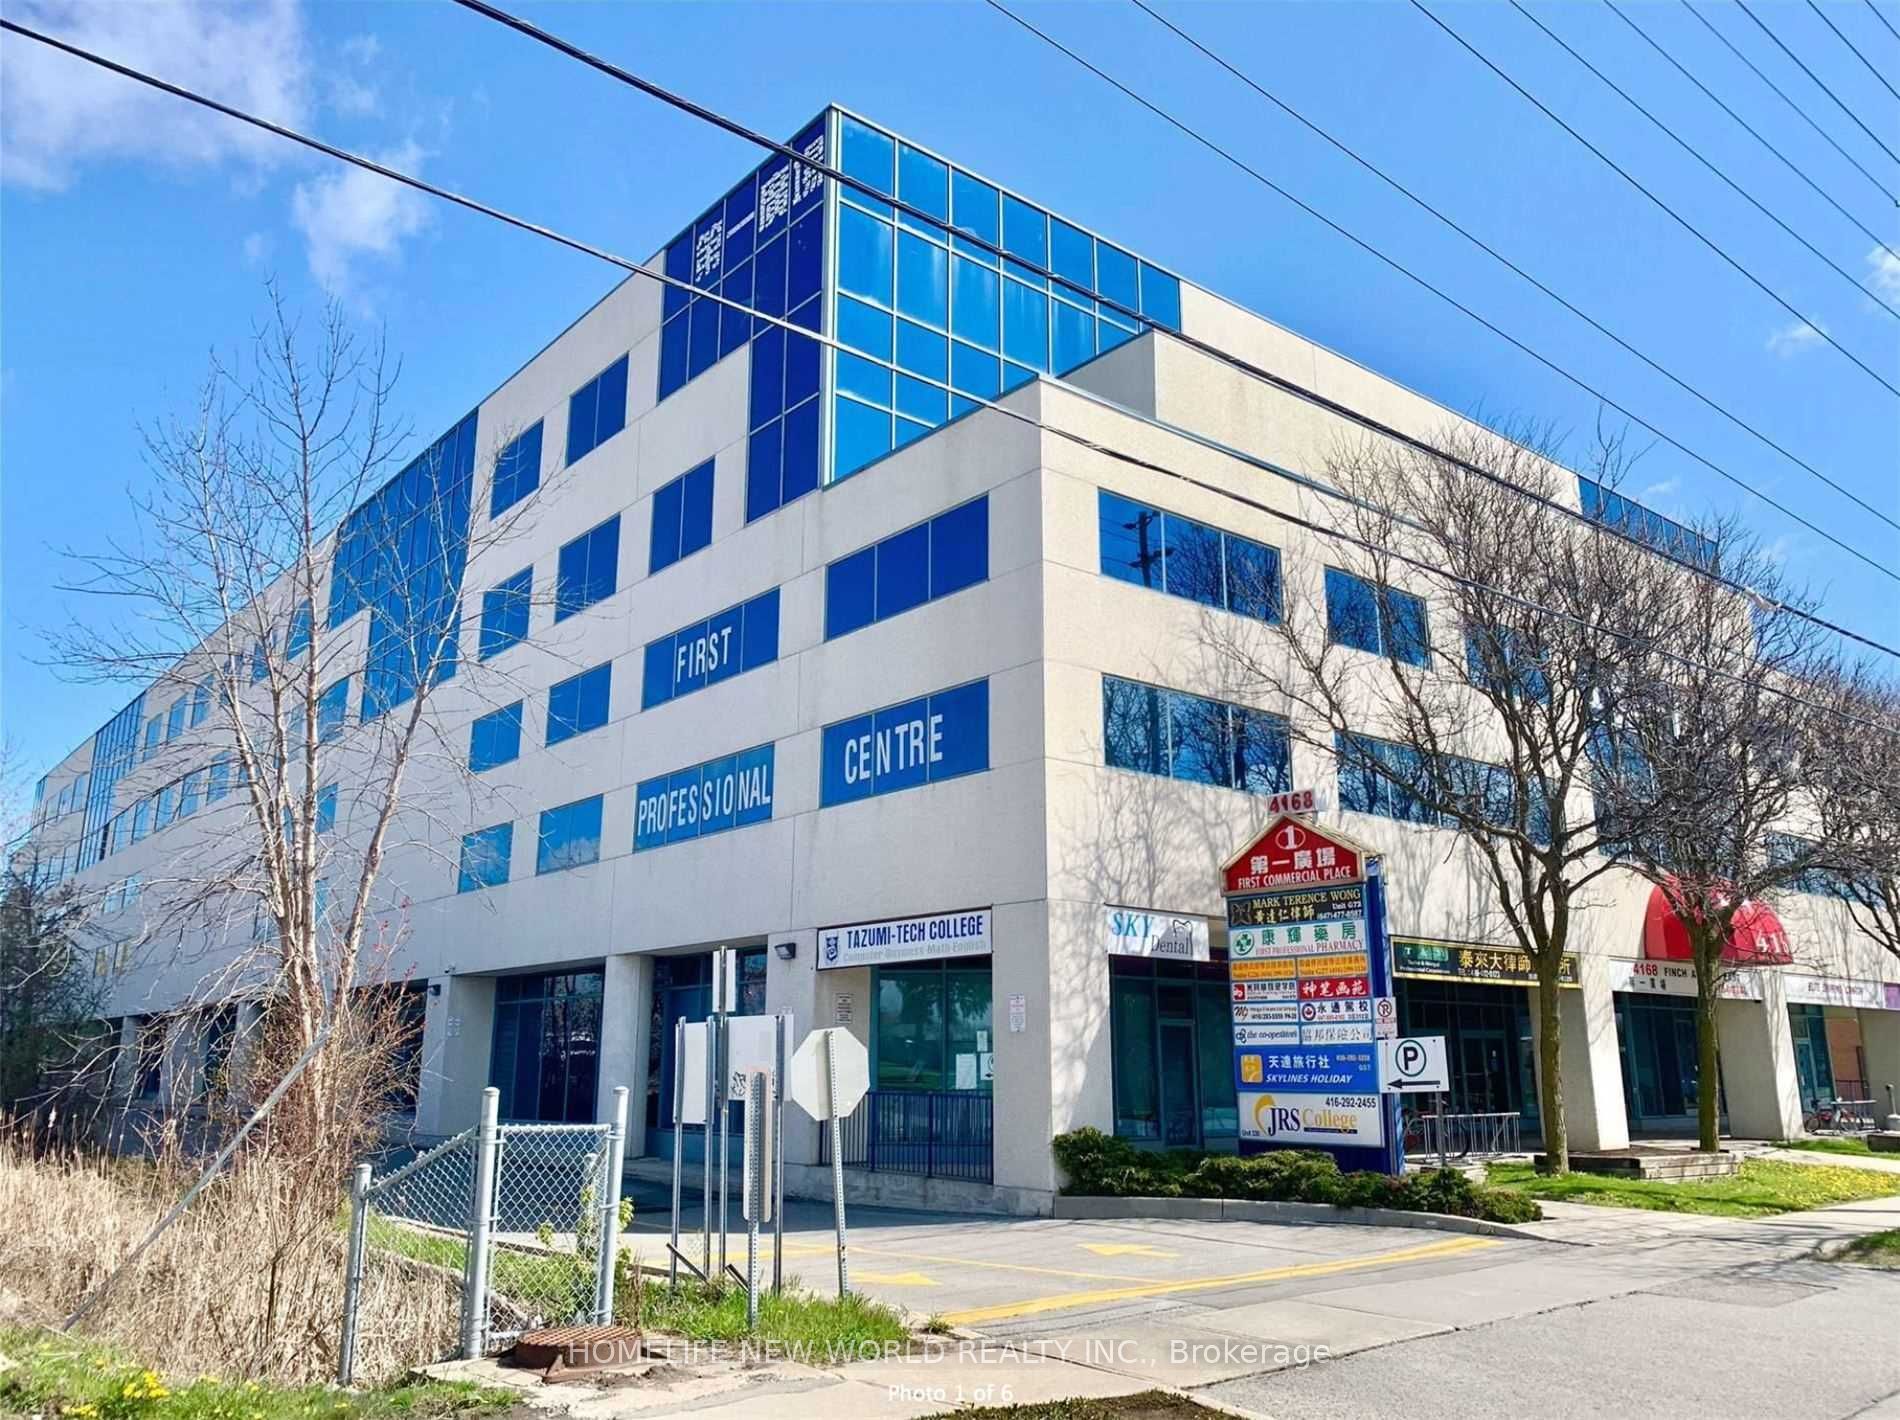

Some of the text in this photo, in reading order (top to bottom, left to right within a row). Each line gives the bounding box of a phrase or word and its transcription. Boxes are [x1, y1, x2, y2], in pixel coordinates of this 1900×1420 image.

[676, 626, 732, 683] FIRST
[844, 714, 944, 785] CENTRE
[637, 764, 771, 837] PROFESSIONAL
[1269, 791, 1313, 814] 4168
[1238, 866, 1351, 889] FIRST COMMERCIAL PLACE
[1252, 888, 1361, 909] MARK TERENCE WONG
[847, 915, 984, 949] TAZUMI-TECH COLLEGE
[1112, 912, 1154, 938] SKY
[1151, 935, 1188, 955] Dental
[1317, 940, 1362, 953] PHARMACY
[1633, 962, 1658, 977] 4168
[1664, 967, 1687, 978] FINCH
[1403, 1046, 1418, 1071] P
[1266, 1073, 1353, 1084] SKYLINES HOLIDAY
[1325, 1097, 1377, 1108] 416-292-2455
[1268, 1107, 1358, 1137] JRS College
